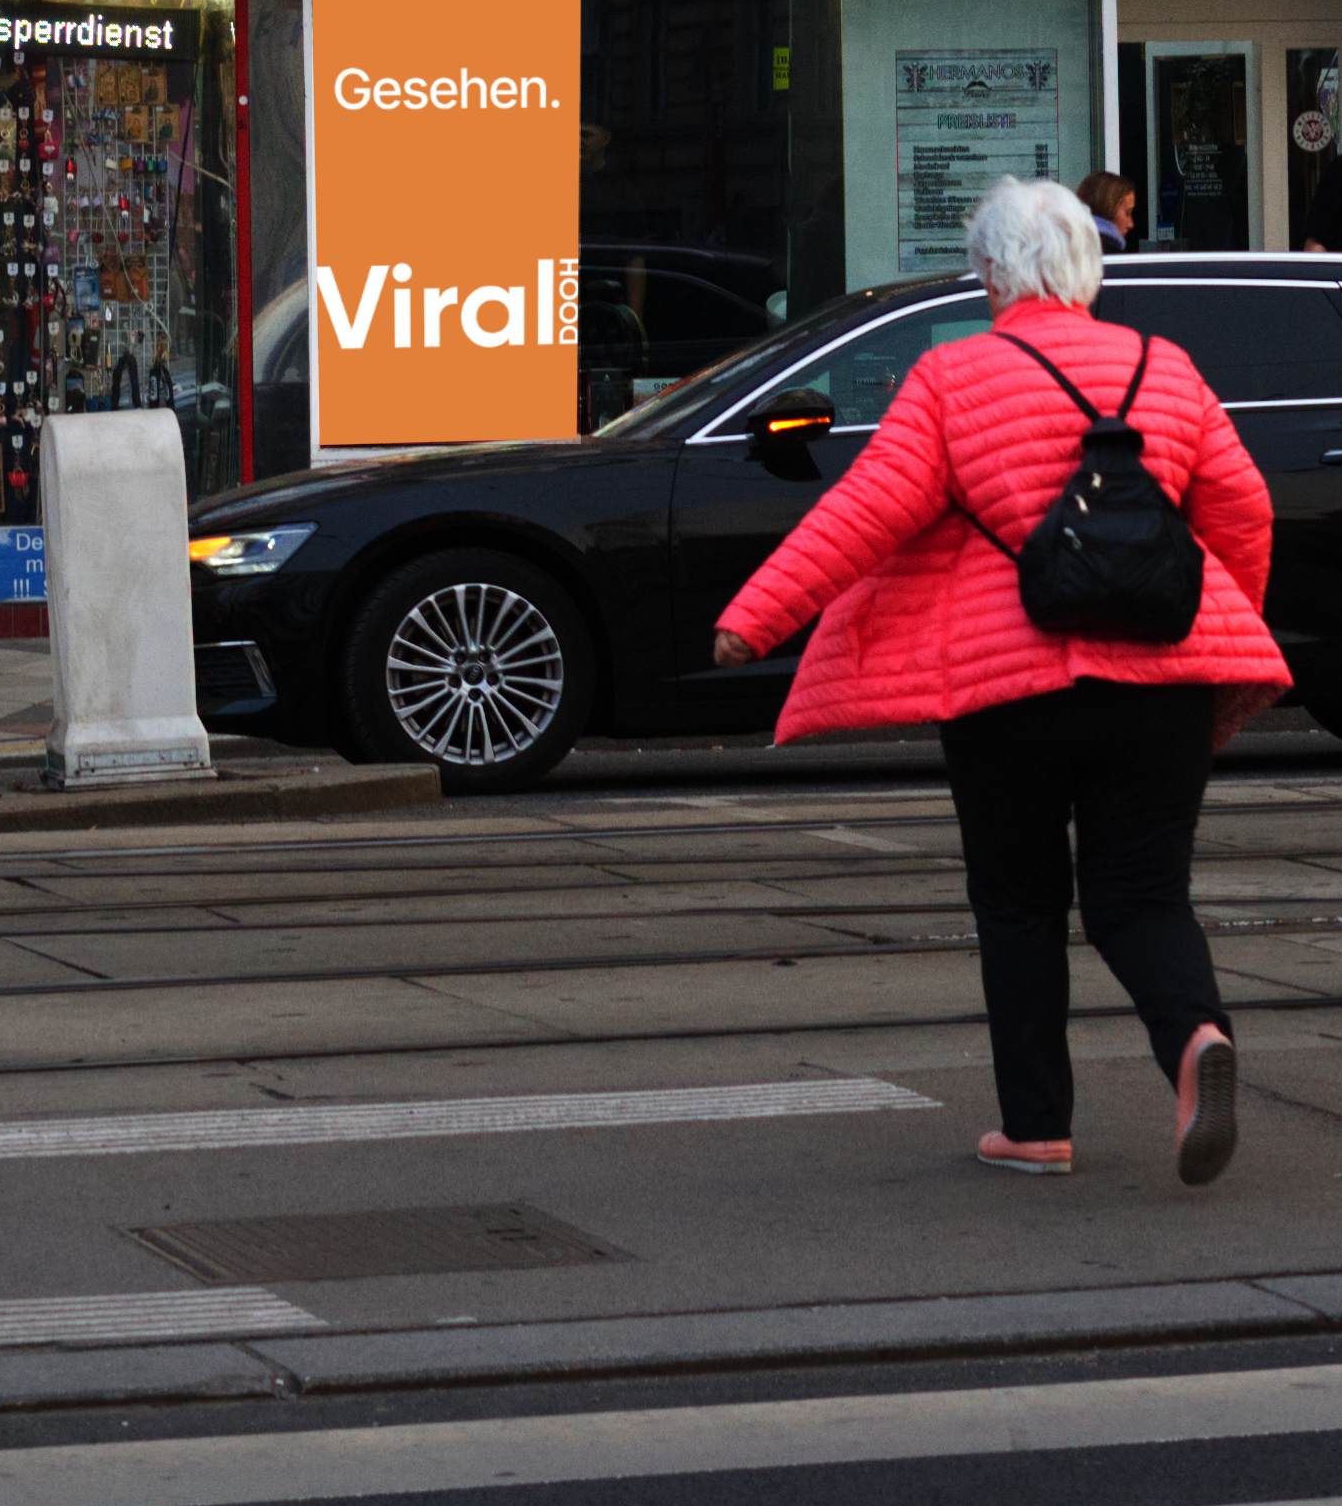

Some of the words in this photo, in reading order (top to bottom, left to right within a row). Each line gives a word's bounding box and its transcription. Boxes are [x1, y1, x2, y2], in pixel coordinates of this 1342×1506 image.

[333, 66, 561, 110] Gesehen.
[929, 62, 1025, 81] HERMANOS
[937, 112, 1016, 129] PREISLISTE
[316, 258, 554, 350] Viral
[558, 257, 579, 345] DOOH
